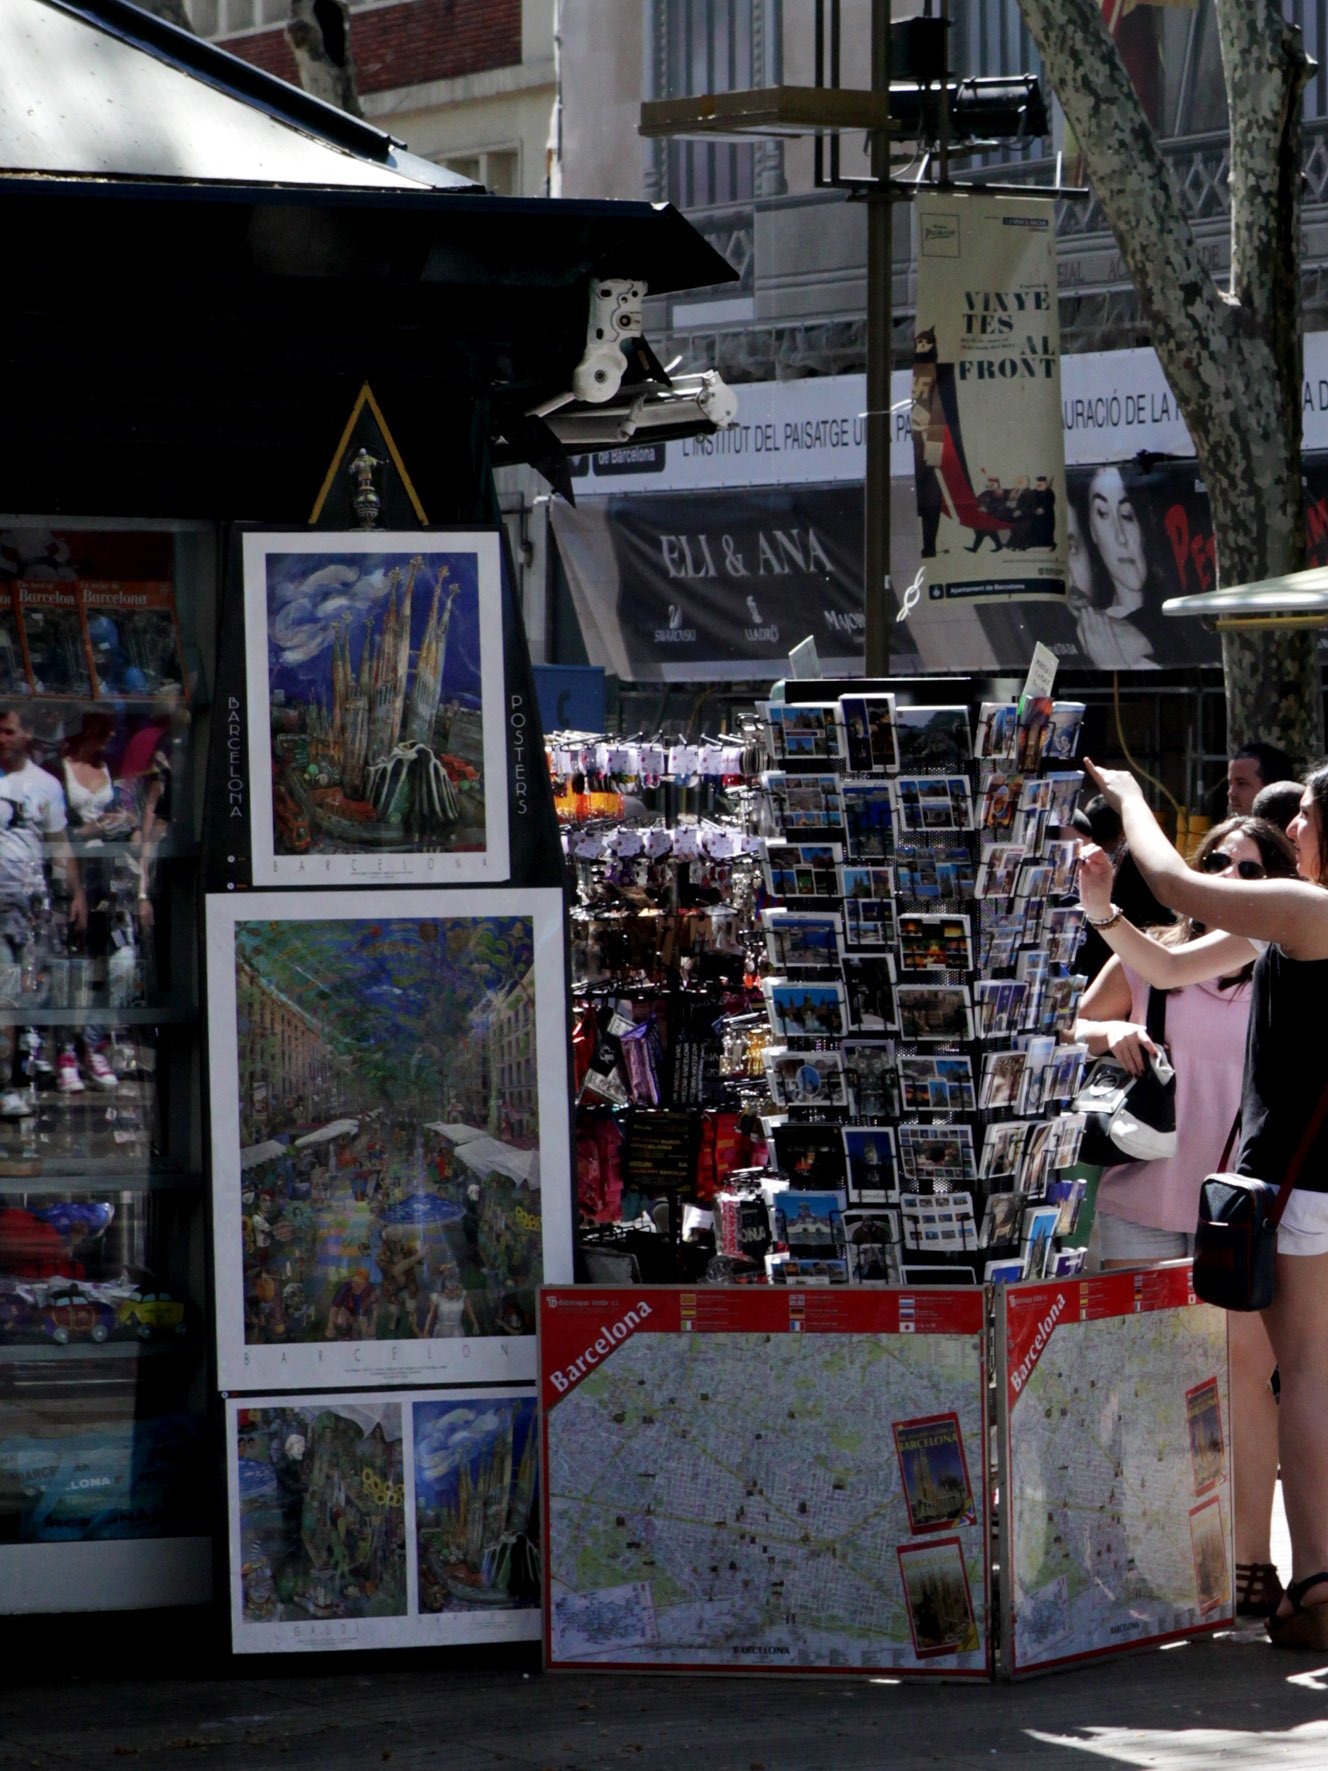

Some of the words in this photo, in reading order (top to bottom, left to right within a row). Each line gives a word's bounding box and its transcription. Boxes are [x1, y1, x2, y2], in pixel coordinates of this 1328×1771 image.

[965, 291, 1050, 312] VINYE
[963, 314, 1013, 334] TES
[1021, 336, 1056, 356] AL
[959, 358, 1056, 380] FRONT
[1062, 389, 1121, 430] URACIÓ
[1125, 394, 1146, 426] DE
[1151, 392, 1171, 423] LA
[682, 426, 751, 457] LINSTITUT
[755, 423, 780, 451] DEL
[784, 418, 849, 450] PAISATGE
[660, 535, 717, 578] ELI
[722, 534, 749, 577] &
[758, 528, 834, 576] ANA
[19, 589, 74, 605] Barcelon
[82, 588, 148, 606] Barcelona
[227, 696, 244, 817] BARCELONA
[511, 695, 528, 815] POSTERS
[549, 1298, 653, 1394] Barcelona
[1010, 1292, 1067, 1393] Barcelona
[243, 1345, 511, 1366] BARCELON
[899, 1433, 959, 1452] BARCELONA
[733, 1645, 791, 1655] BARCELONA
